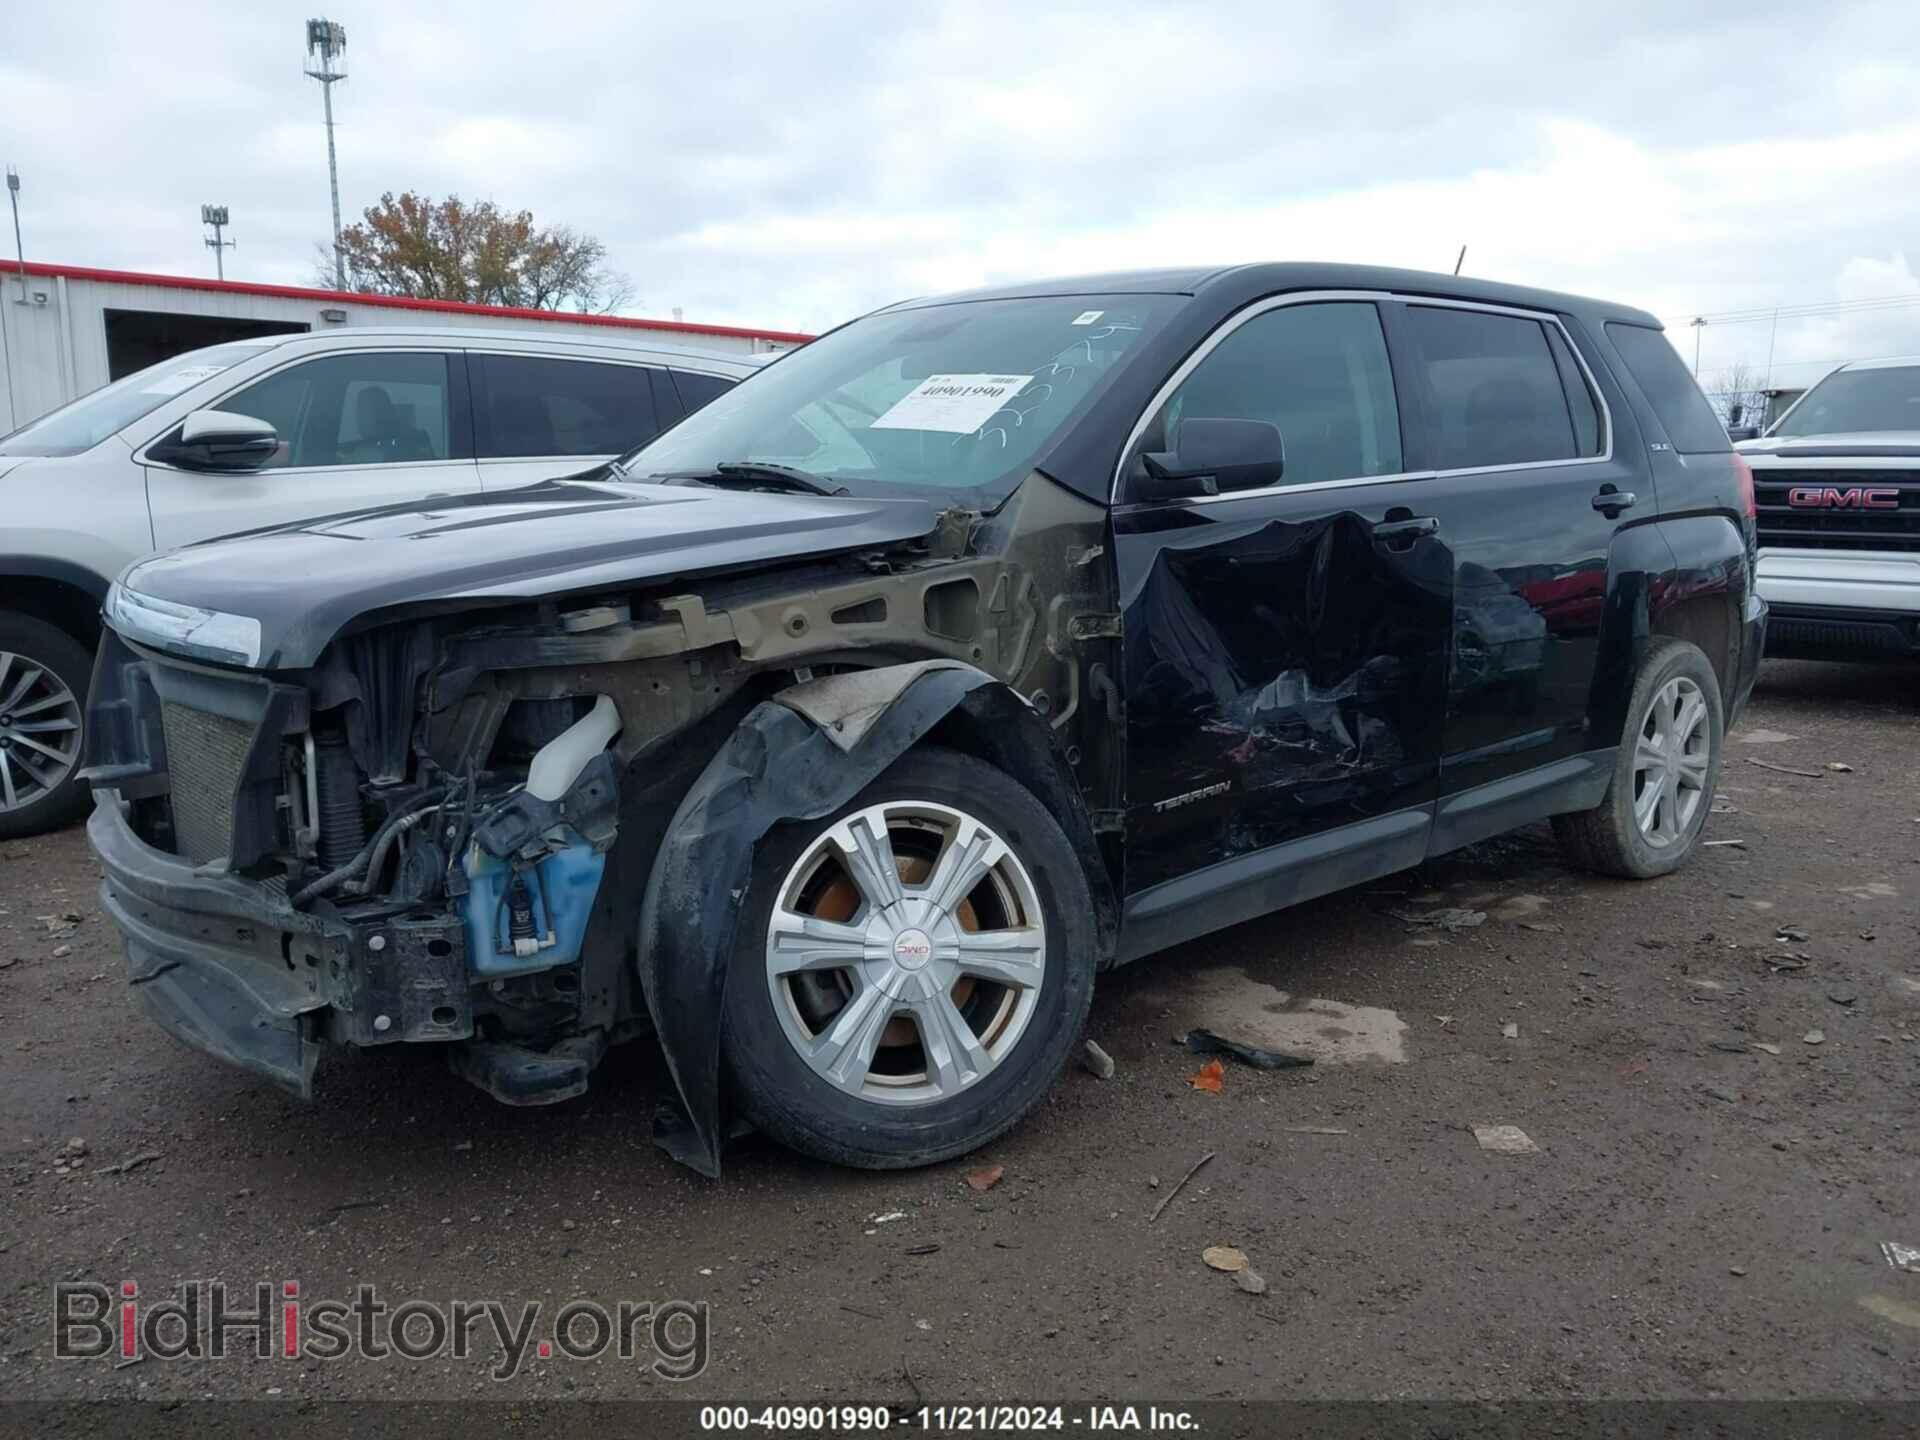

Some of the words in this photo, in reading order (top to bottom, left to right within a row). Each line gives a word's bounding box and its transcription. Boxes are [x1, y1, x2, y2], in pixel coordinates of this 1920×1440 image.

[1788, 487, 1900, 508] GMC
[1153, 779, 1231, 813] TERRAIN
[896, 944, 929, 954] GMC
